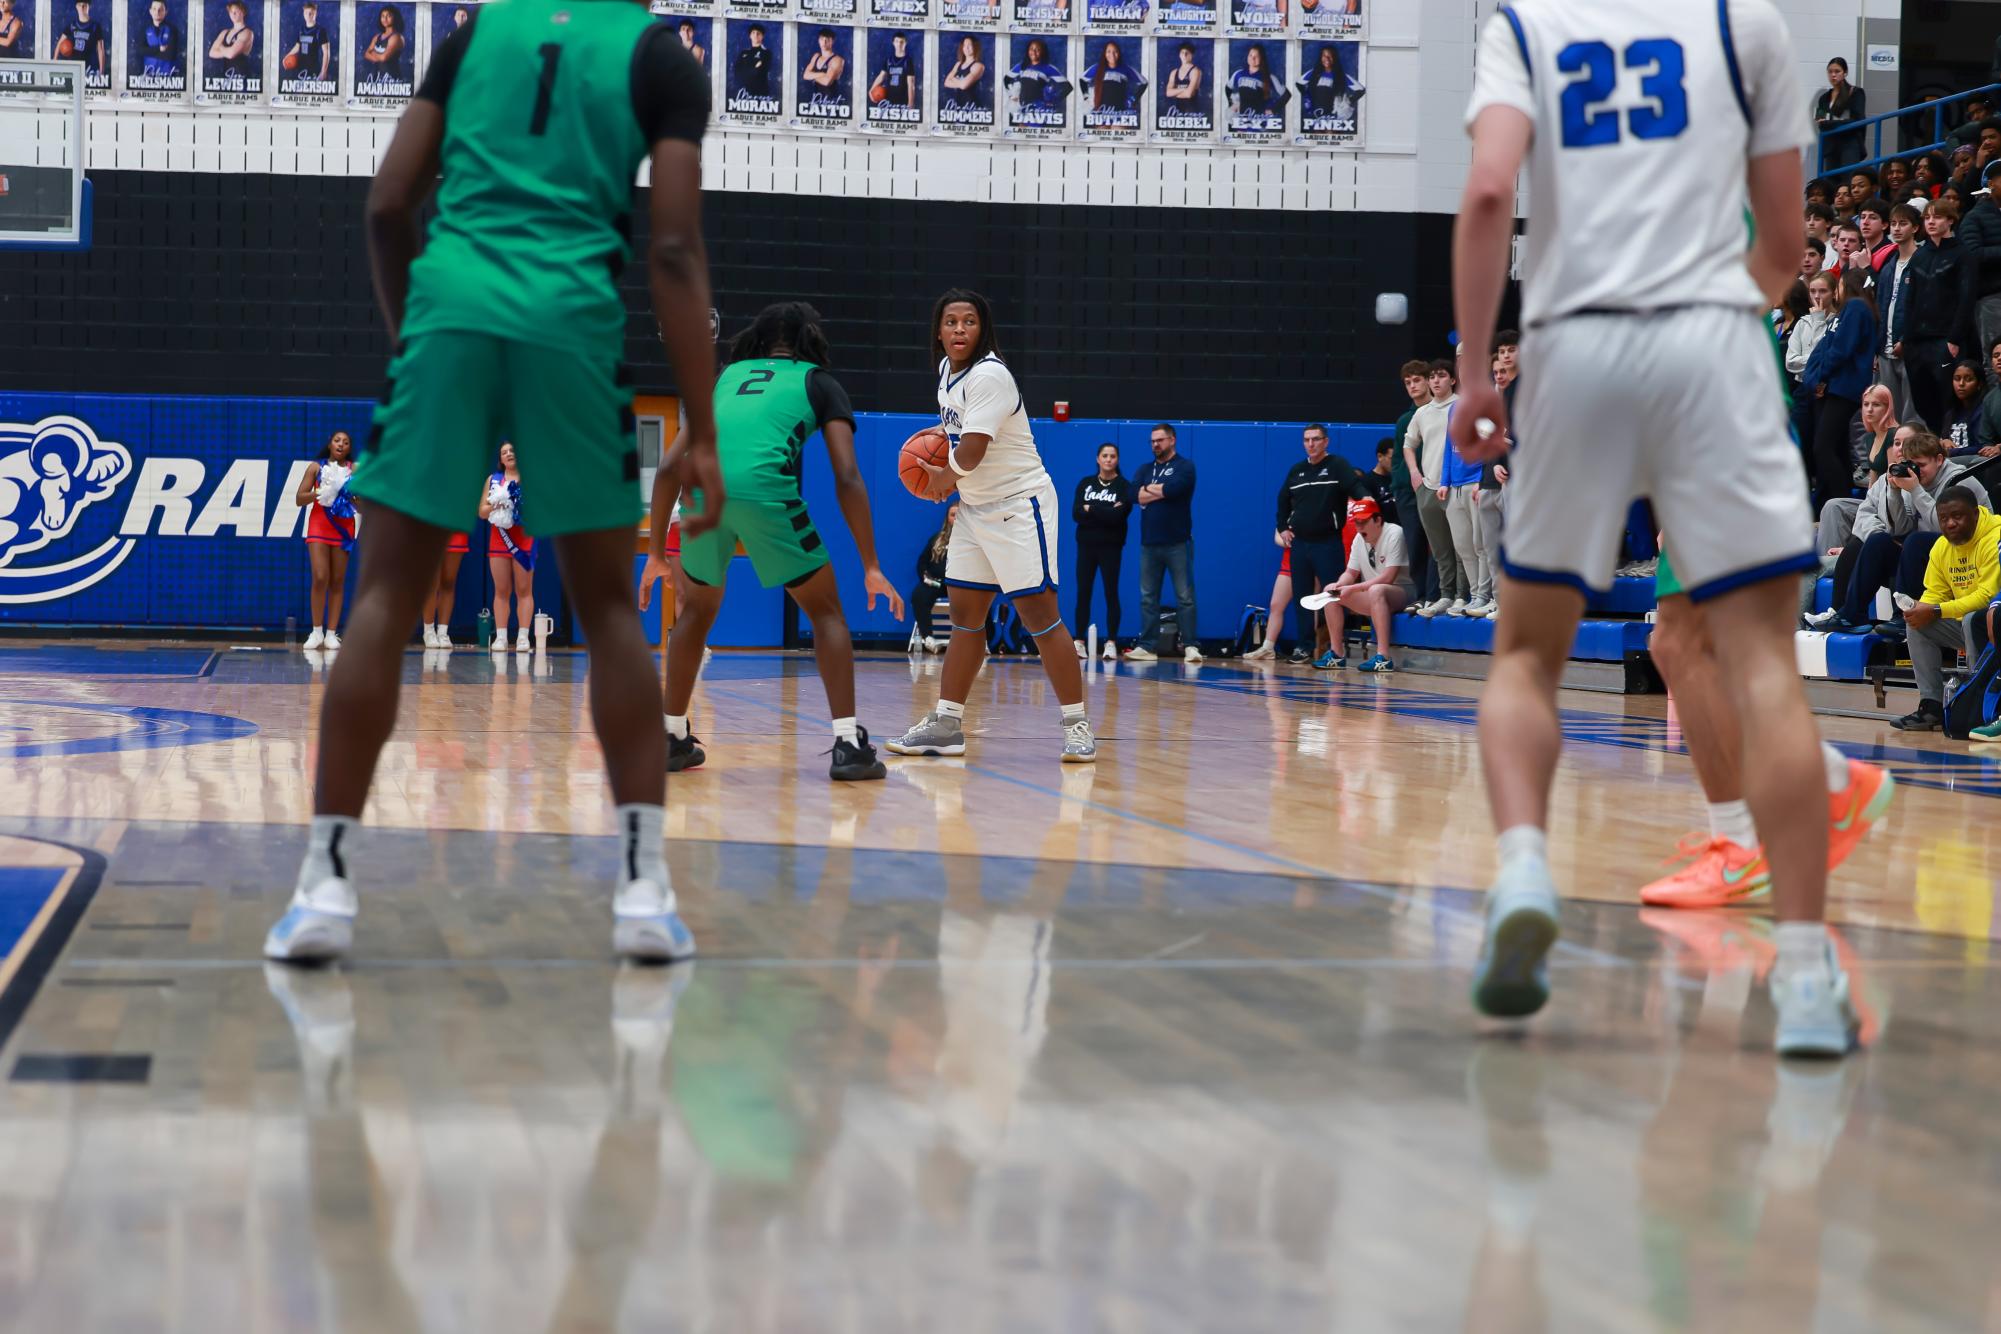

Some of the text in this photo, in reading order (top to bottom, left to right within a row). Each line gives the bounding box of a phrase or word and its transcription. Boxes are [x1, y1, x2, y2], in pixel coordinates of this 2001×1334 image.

[129, 75, 184, 90] ENGELSMANN
[205, 77, 260, 92] LEWIS III
[281, 80, 336, 94] ANDERSON
[528, 43, 562, 137] 1
[1557, 39, 1688, 148] 23
[728, 98, 779, 113] MORAN
[798, 102, 850, 117] CAITO
[869, 107, 920, 121] BISIG
[940, 110, 992, 123] SUMMERS
[1012, 112, 1063, 124] DAVIS
[1086, 114, 1137, 126] BUTLER
[1159, 116, 1211, 129] GOEBEL
[1303, 118, 1354, 131] PINEX
[736, 370, 776, 395] 2
